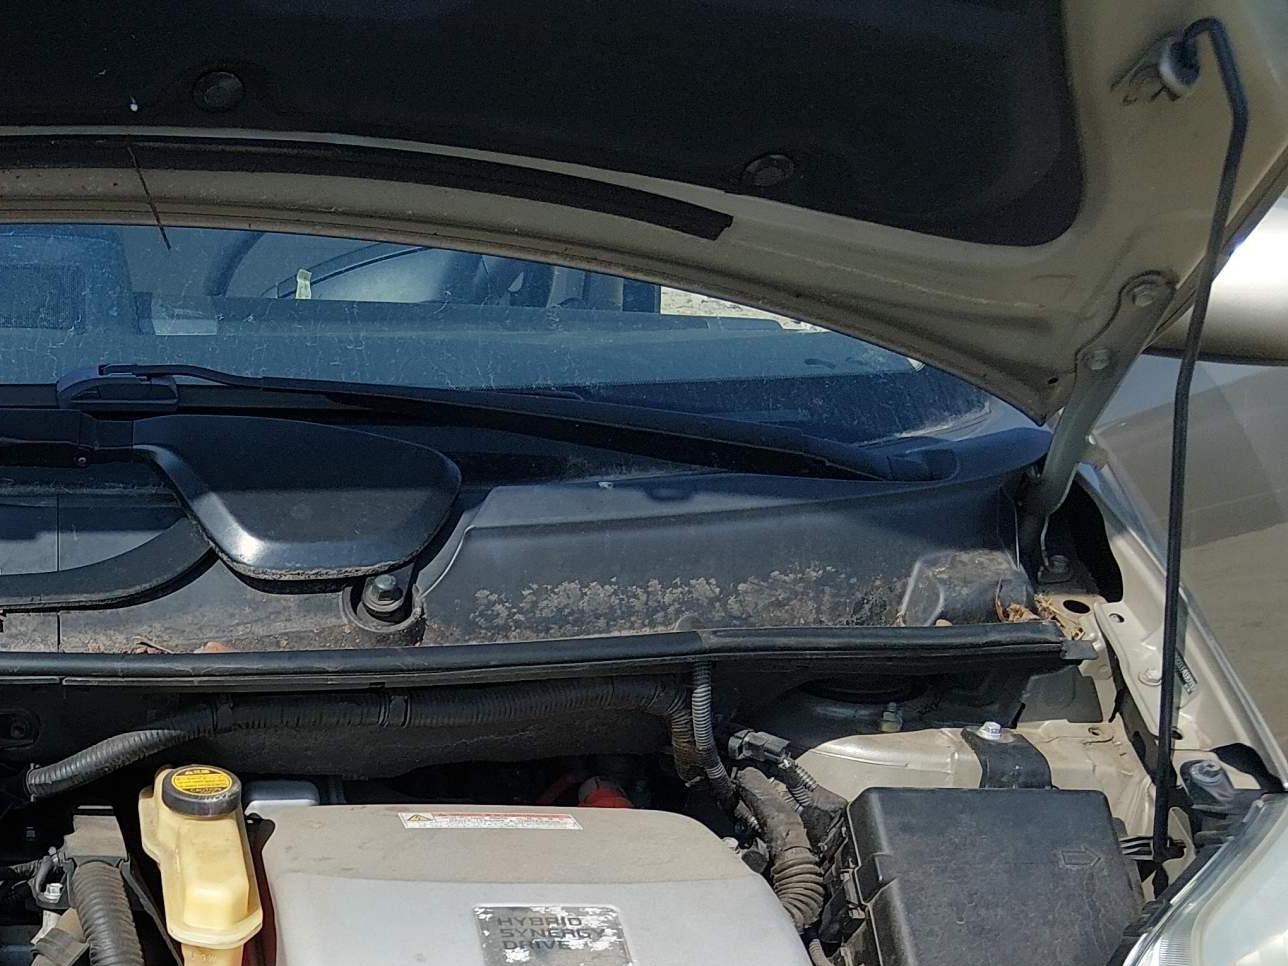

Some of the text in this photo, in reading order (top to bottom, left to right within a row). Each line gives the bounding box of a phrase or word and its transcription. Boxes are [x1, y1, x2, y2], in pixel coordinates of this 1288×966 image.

[497, 916, 582, 928] HYBRID
[499, 927, 605, 939] SYNERGY
[503, 939, 571, 951] DRIVE
